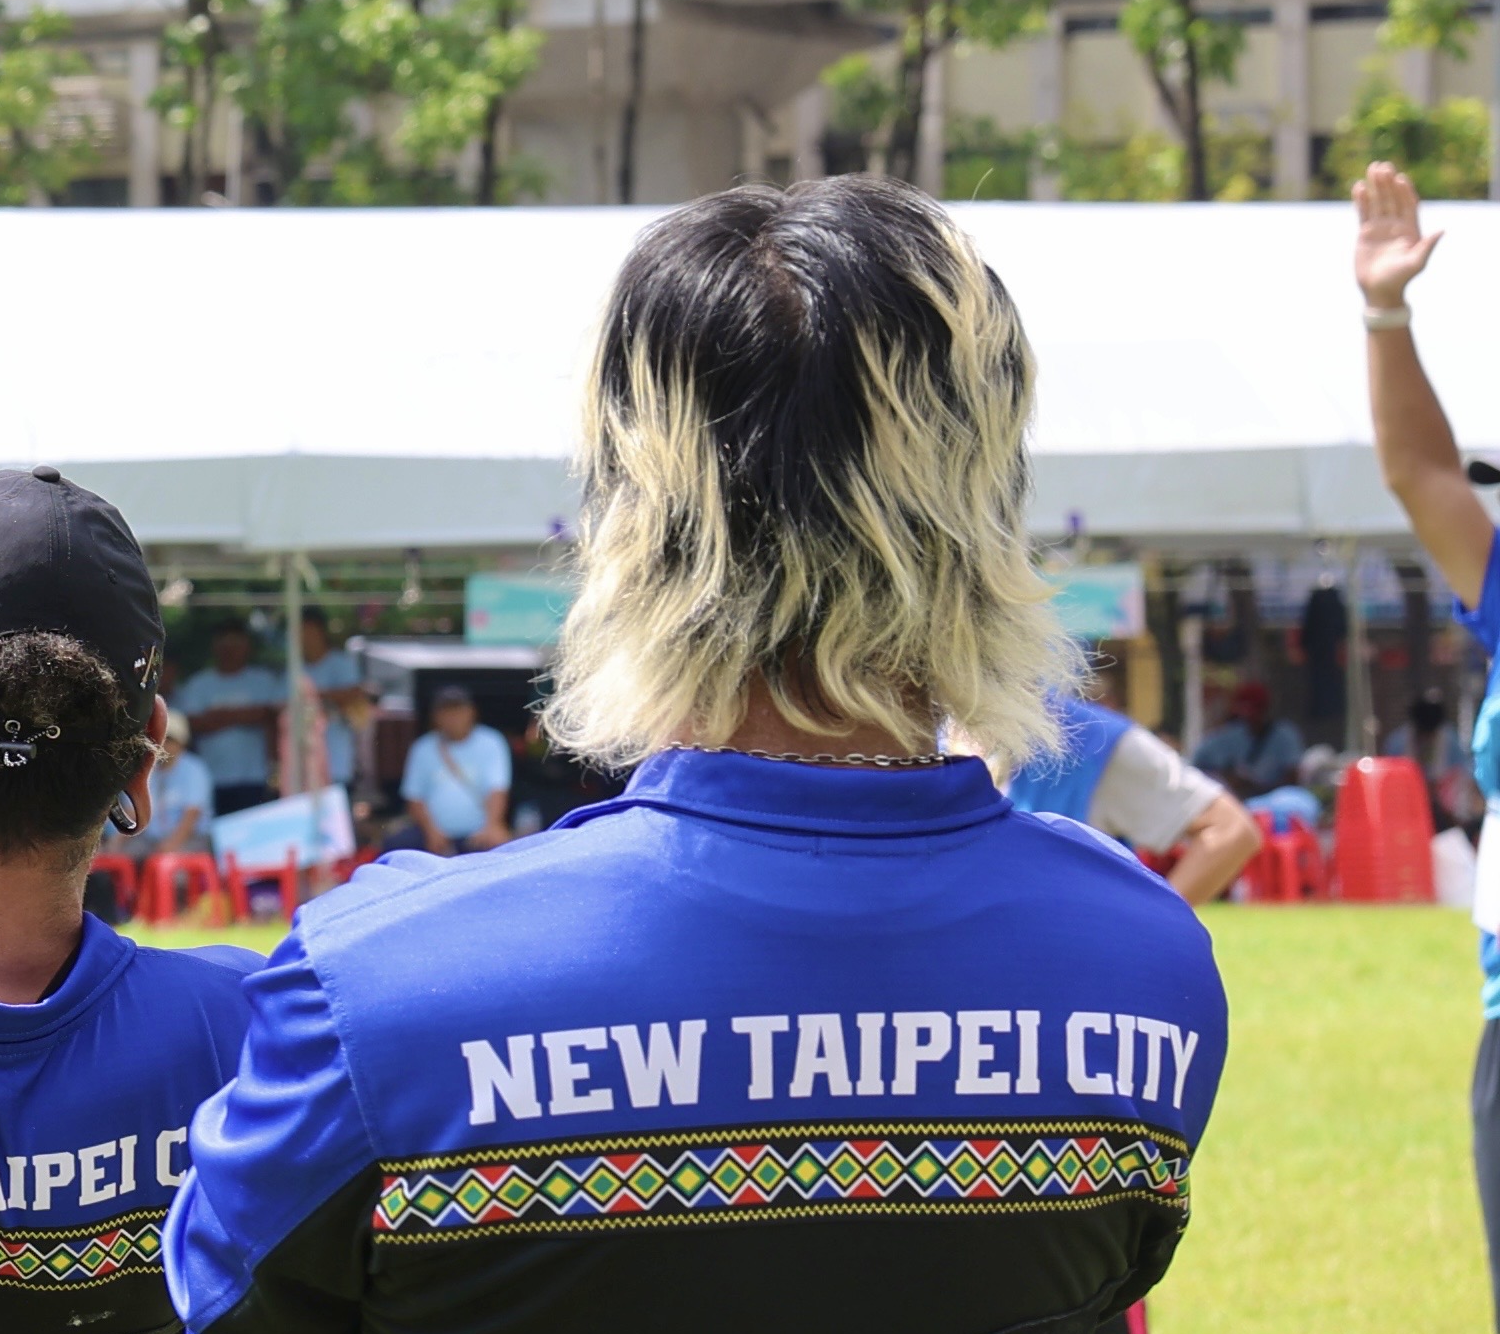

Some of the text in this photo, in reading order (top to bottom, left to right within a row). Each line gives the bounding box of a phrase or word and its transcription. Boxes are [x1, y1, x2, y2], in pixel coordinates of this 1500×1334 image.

[461, 1009, 1199, 1125] NEW TAIPEI CITY
